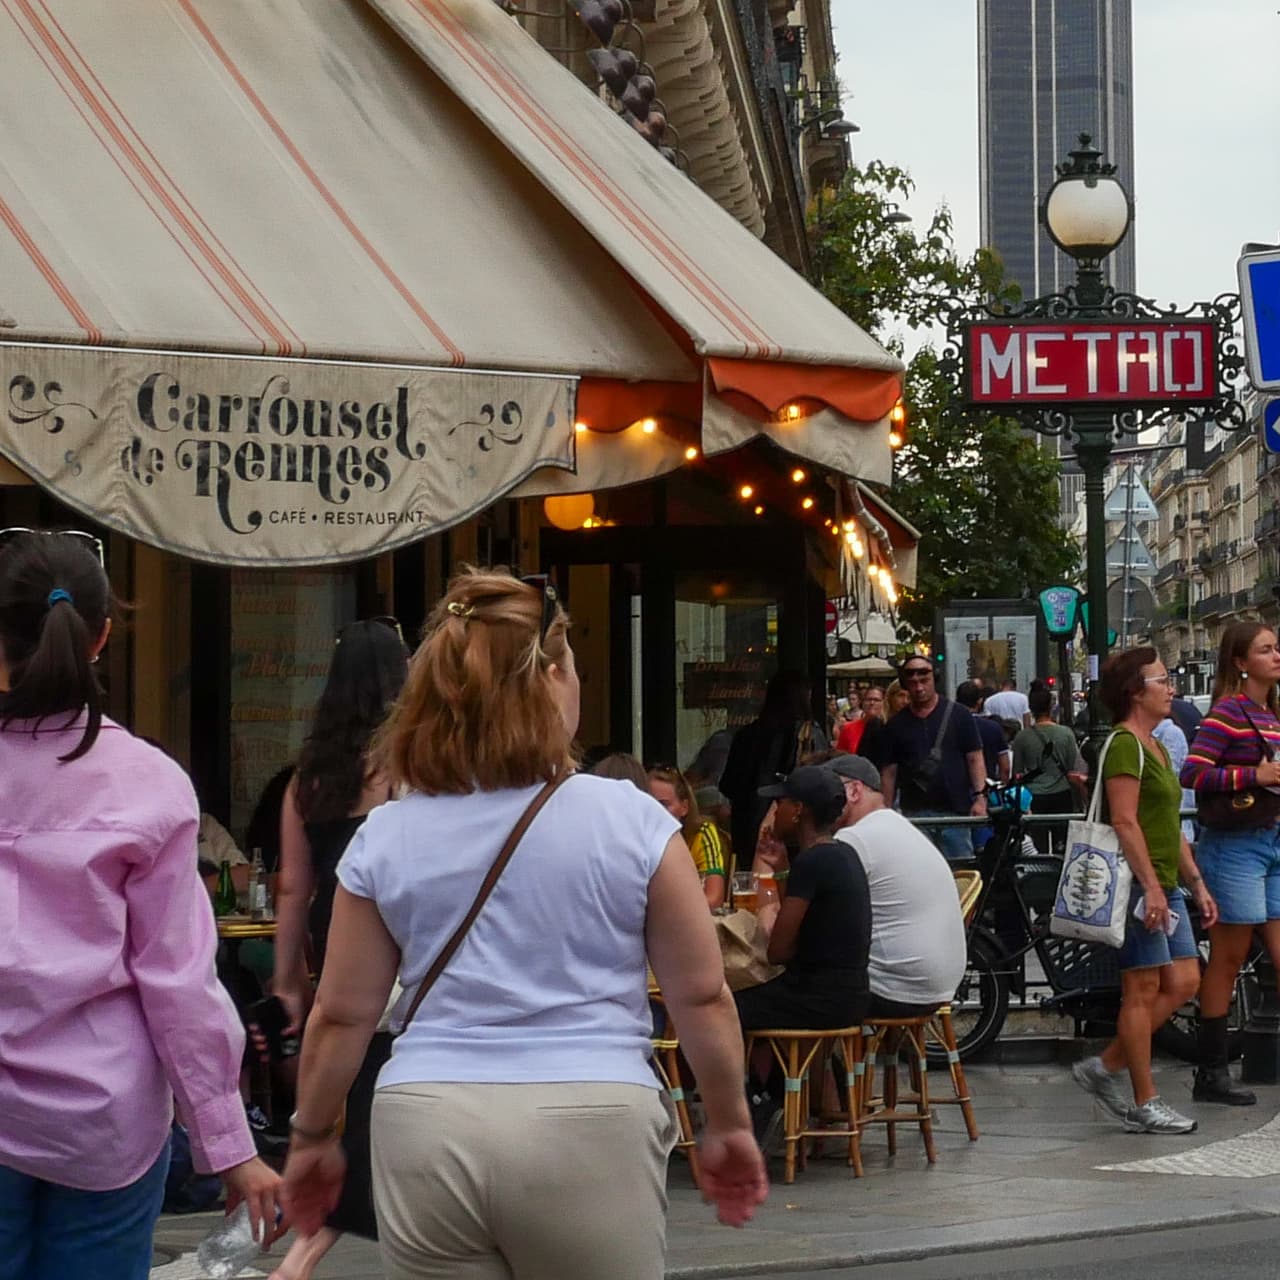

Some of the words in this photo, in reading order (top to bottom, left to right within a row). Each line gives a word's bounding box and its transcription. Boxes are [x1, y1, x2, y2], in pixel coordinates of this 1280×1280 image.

[980, 331, 1204, 395] METRO
[136, 372, 426, 461] Carrousel
[121, 436, 165, 485] de
[175, 437, 392, 535] Rennes
[268, 507, 307, 526] CAFÉ
[325, 509, 425, 526] RESTAURANT
